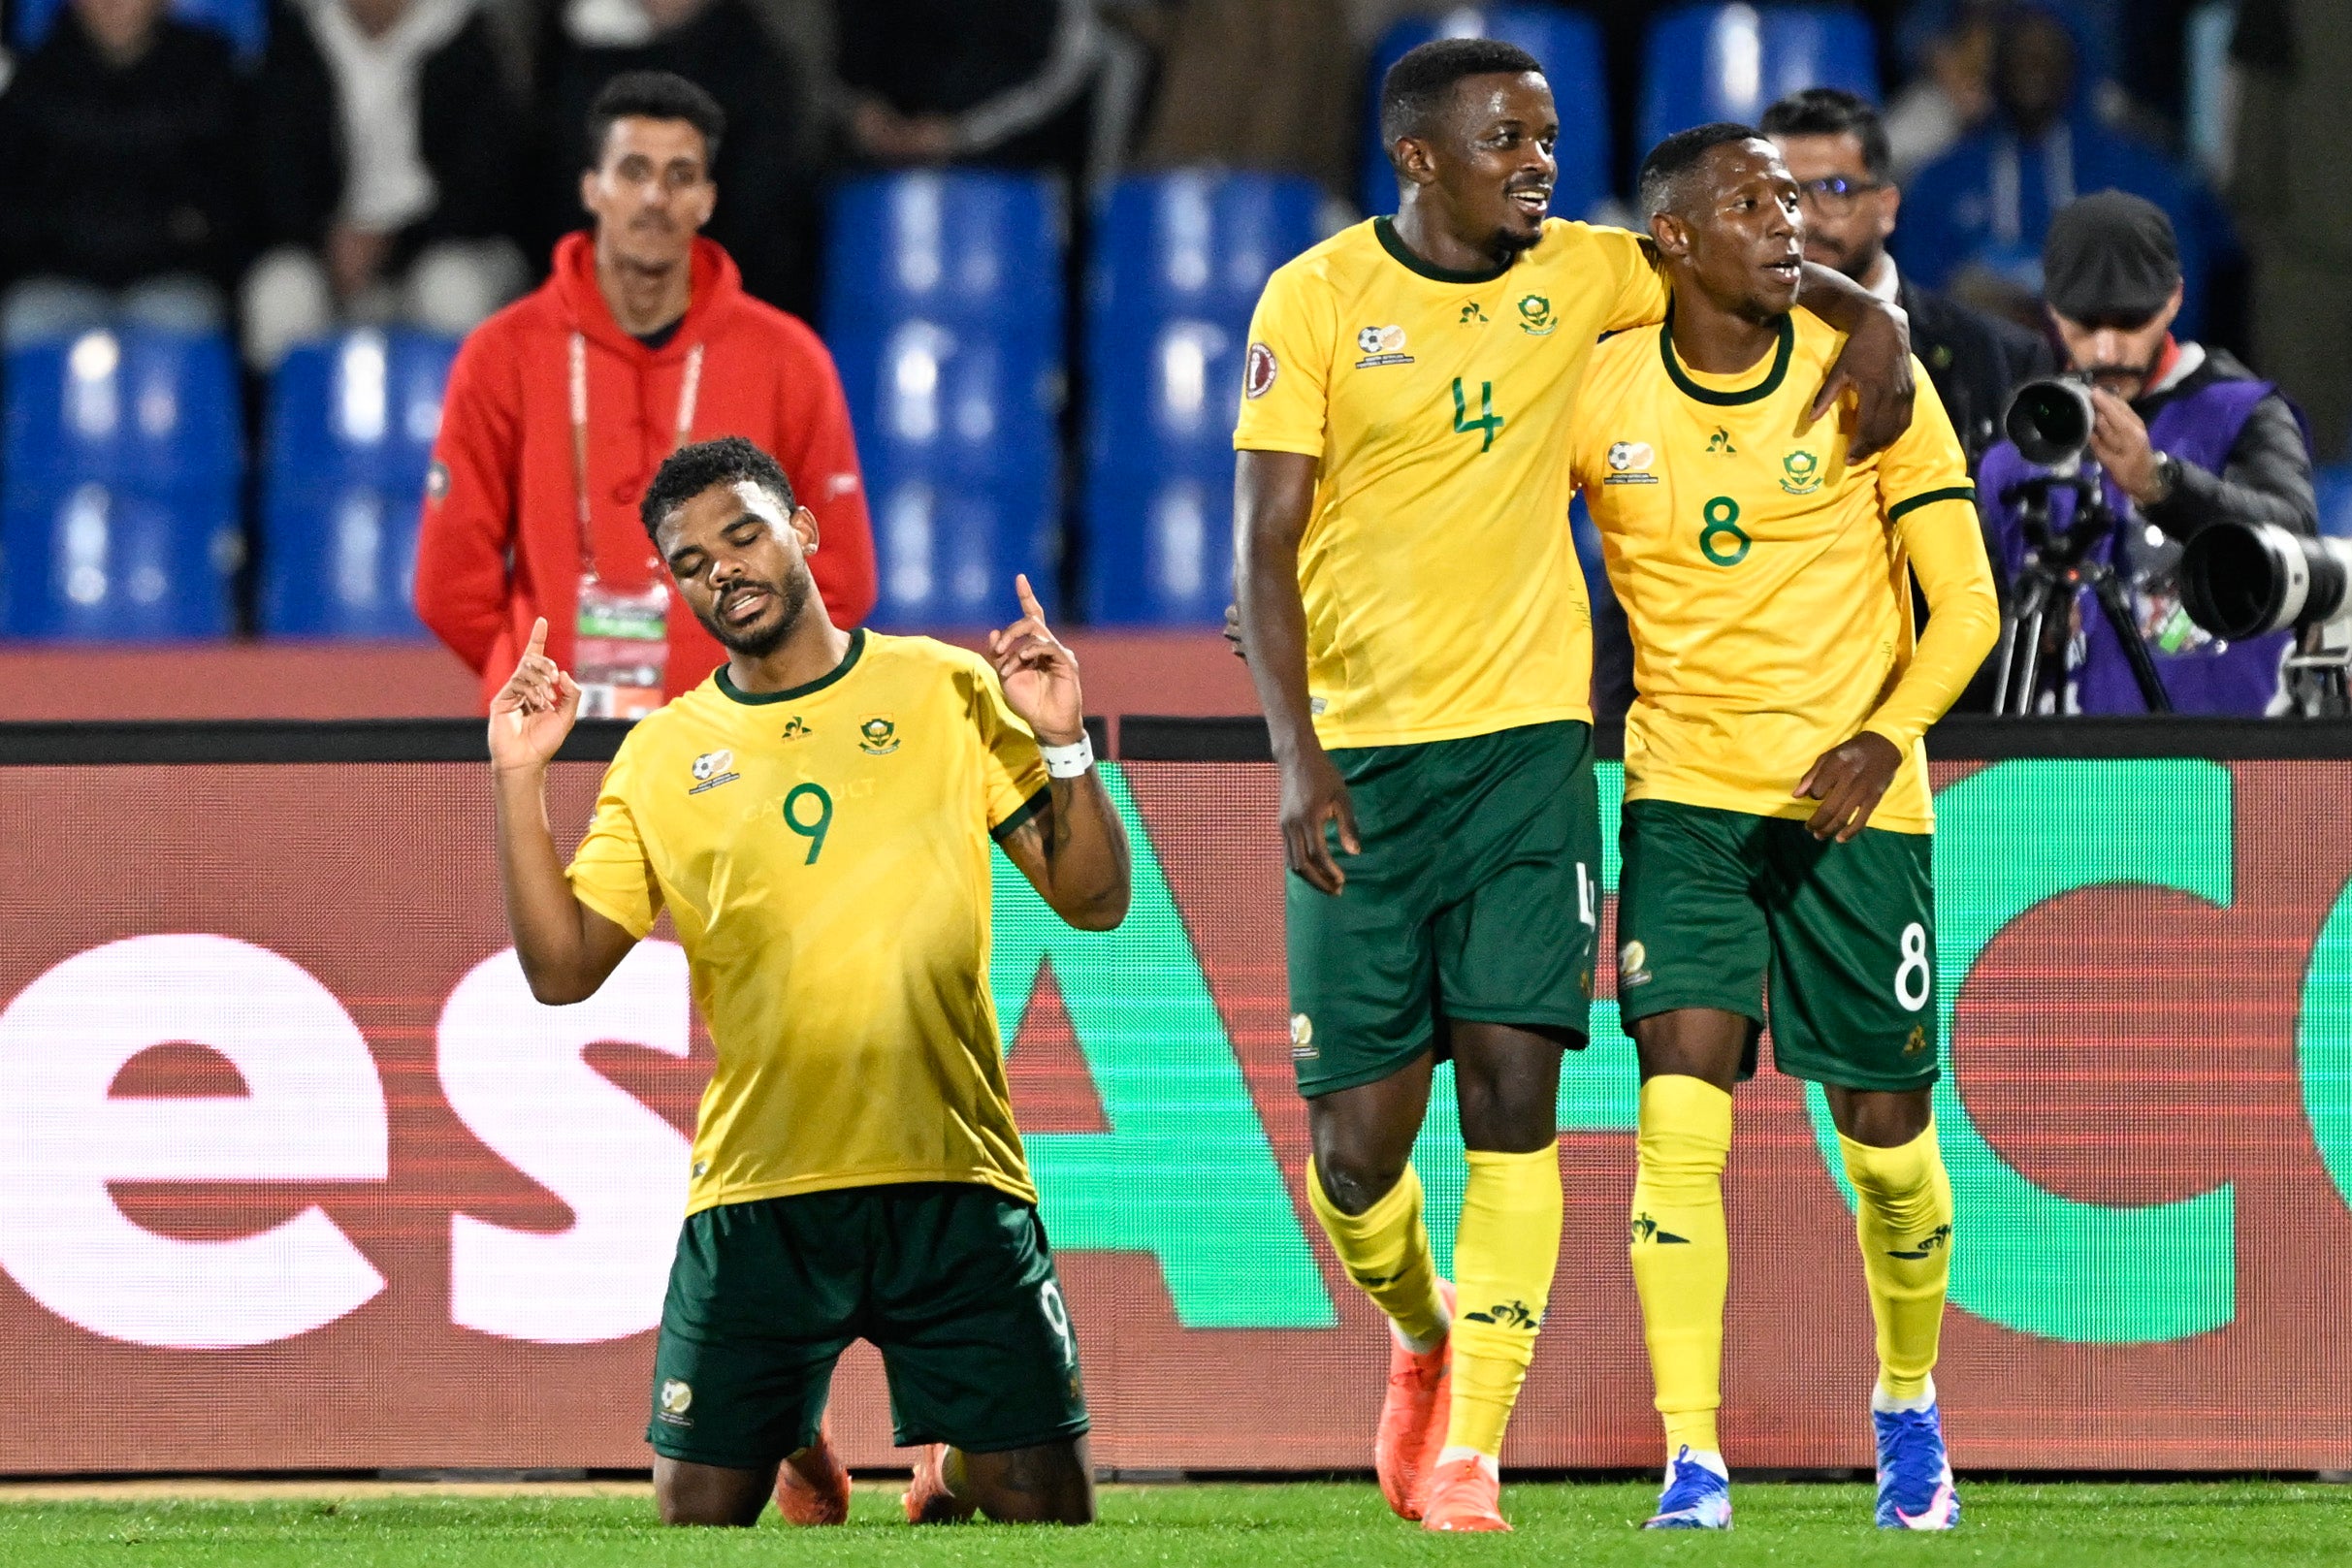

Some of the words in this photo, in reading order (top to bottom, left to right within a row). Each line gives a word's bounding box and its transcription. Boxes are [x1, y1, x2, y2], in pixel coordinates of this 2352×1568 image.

[1452, 376, 1504, 453] 4
[1699, 496, 1753, 567] 8
[742, 777, 877, 823] CAULT
[782, 782, 834, 866] 9
[1894, 921, 1931, 1012] 8
[1041, 1279, 1073, 1365] 9
